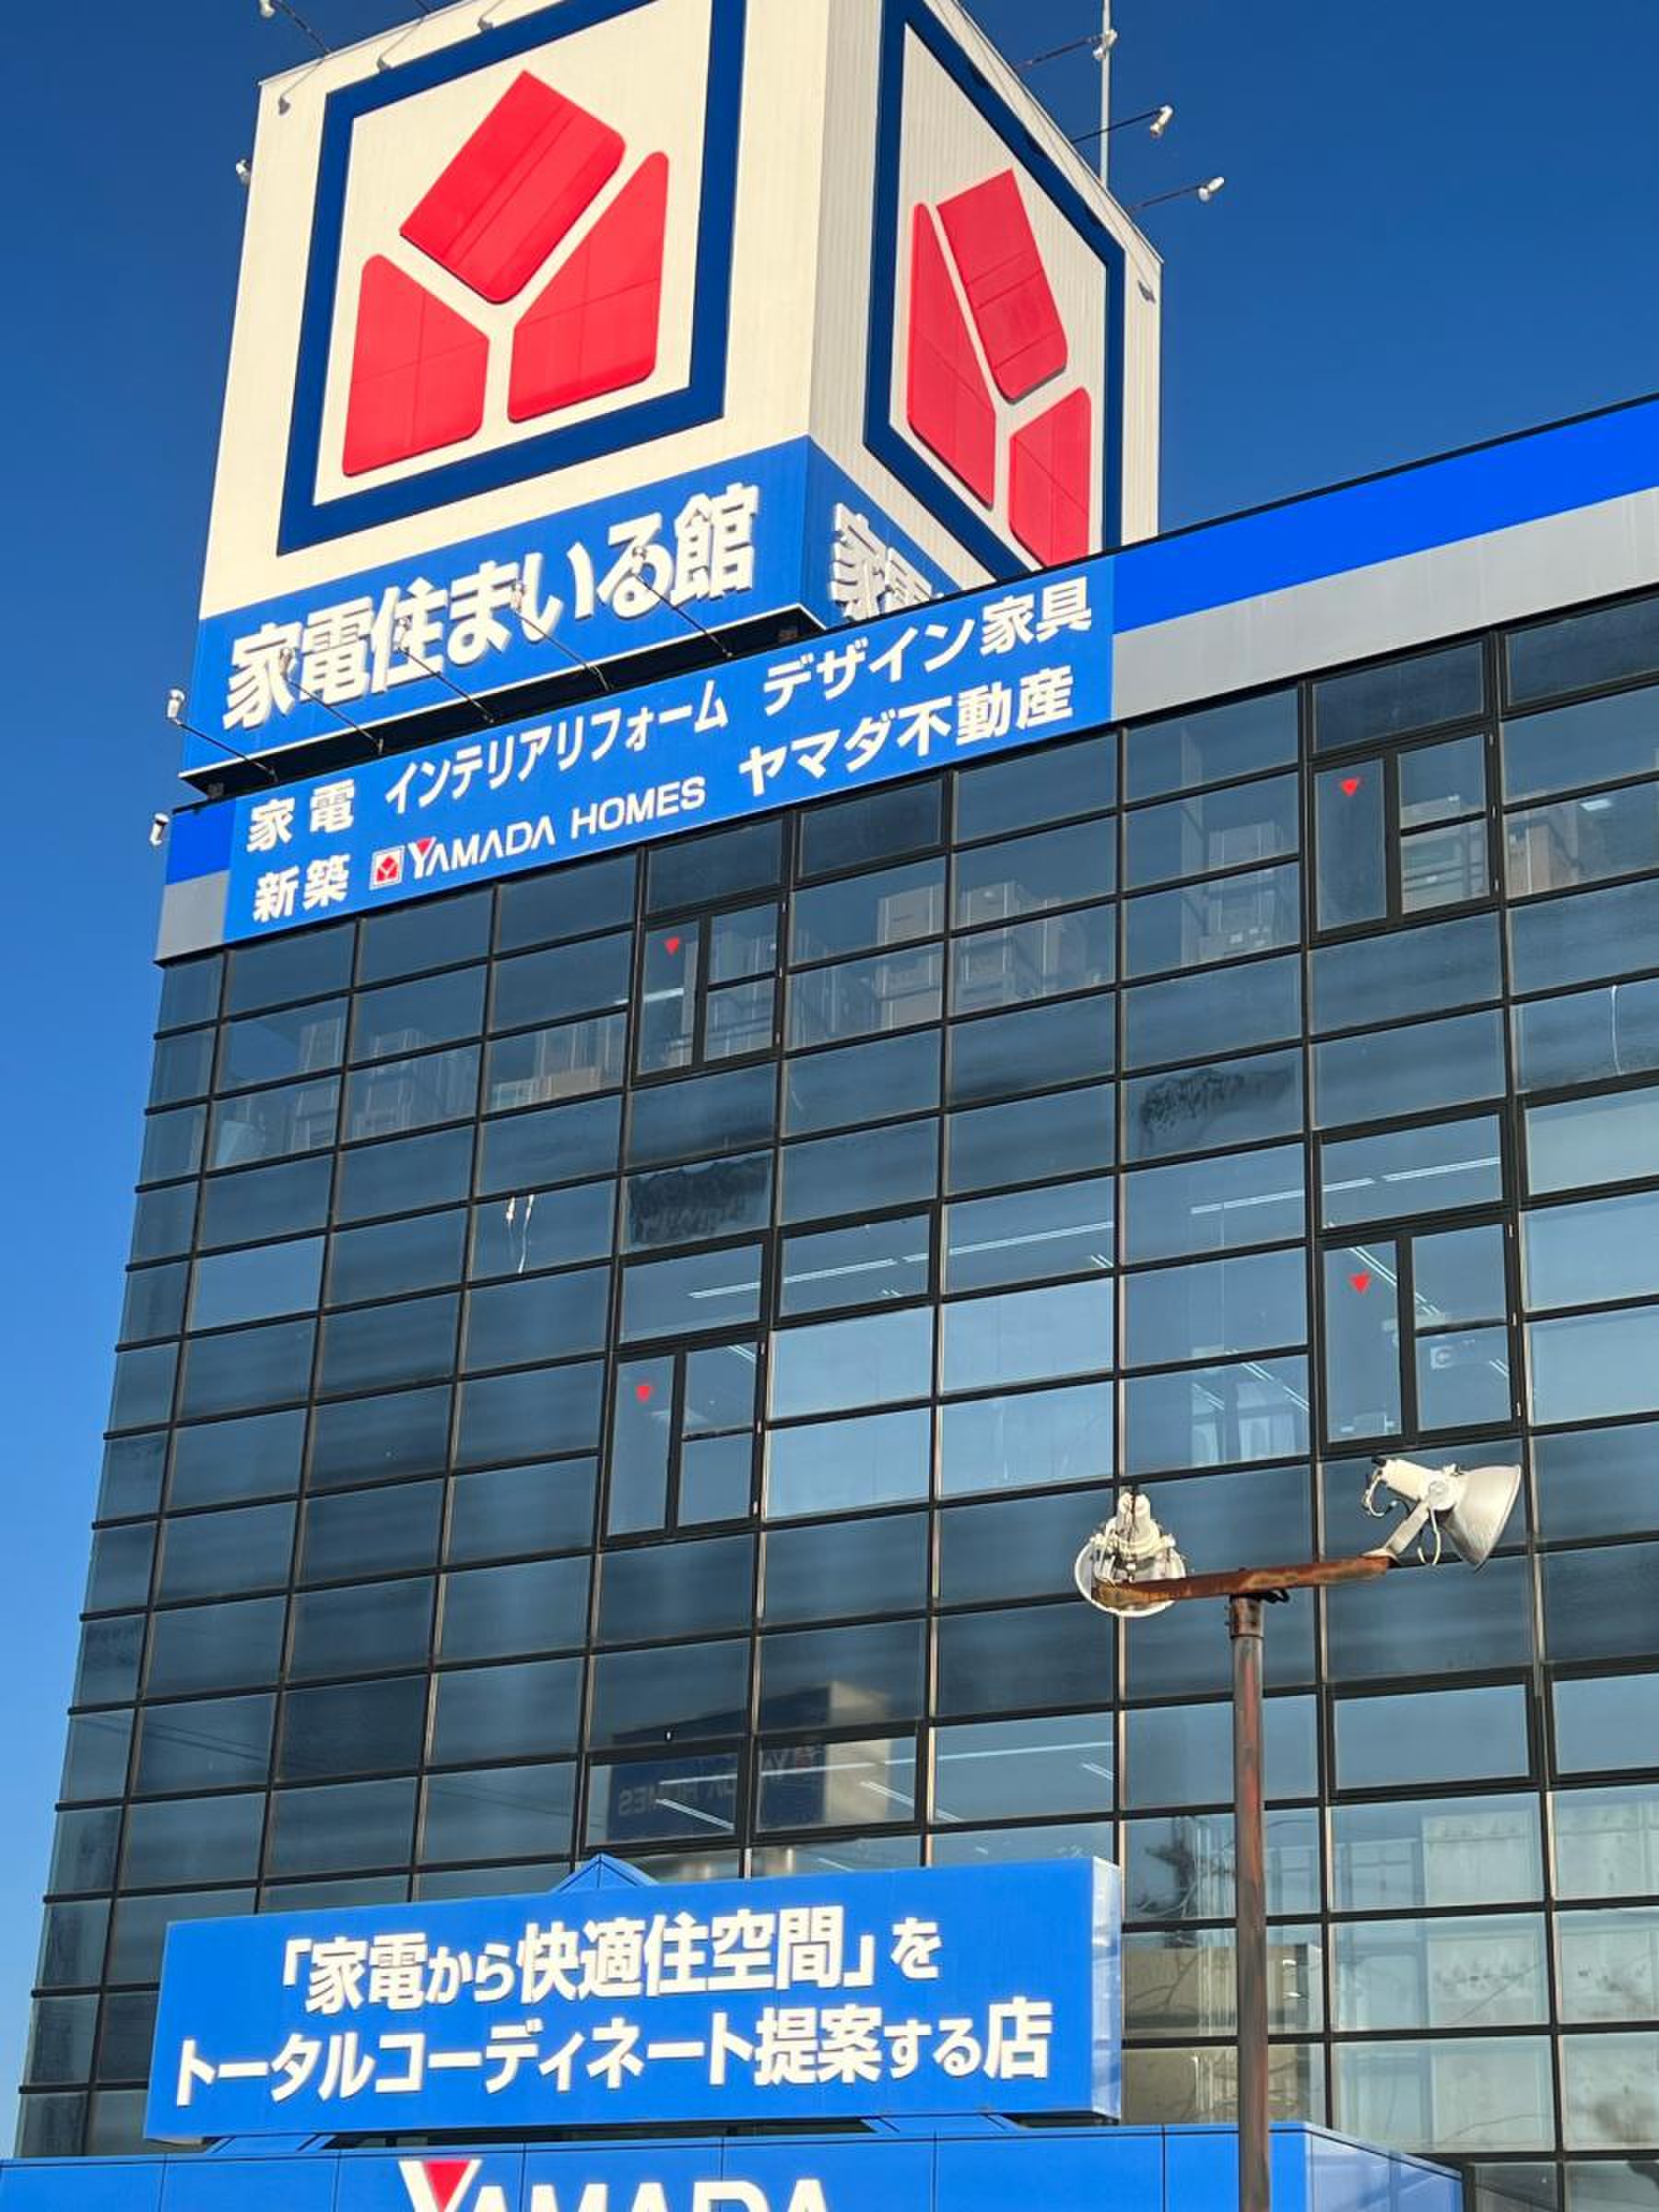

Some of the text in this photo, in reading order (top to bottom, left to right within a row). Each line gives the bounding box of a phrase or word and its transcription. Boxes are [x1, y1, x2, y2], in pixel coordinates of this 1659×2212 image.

[222, 481, 759, 732] 家電住まいる館
[384, 678, 729, 815] インテリアリフォーム
[762, 575, 1093, 717] デザイン家具
[253, 664, 1075, 923] 新築 YAMADA HOMES ヤマダ不動産
[176, 1996, 1053, 2107] トータルコーディネート提案する店
